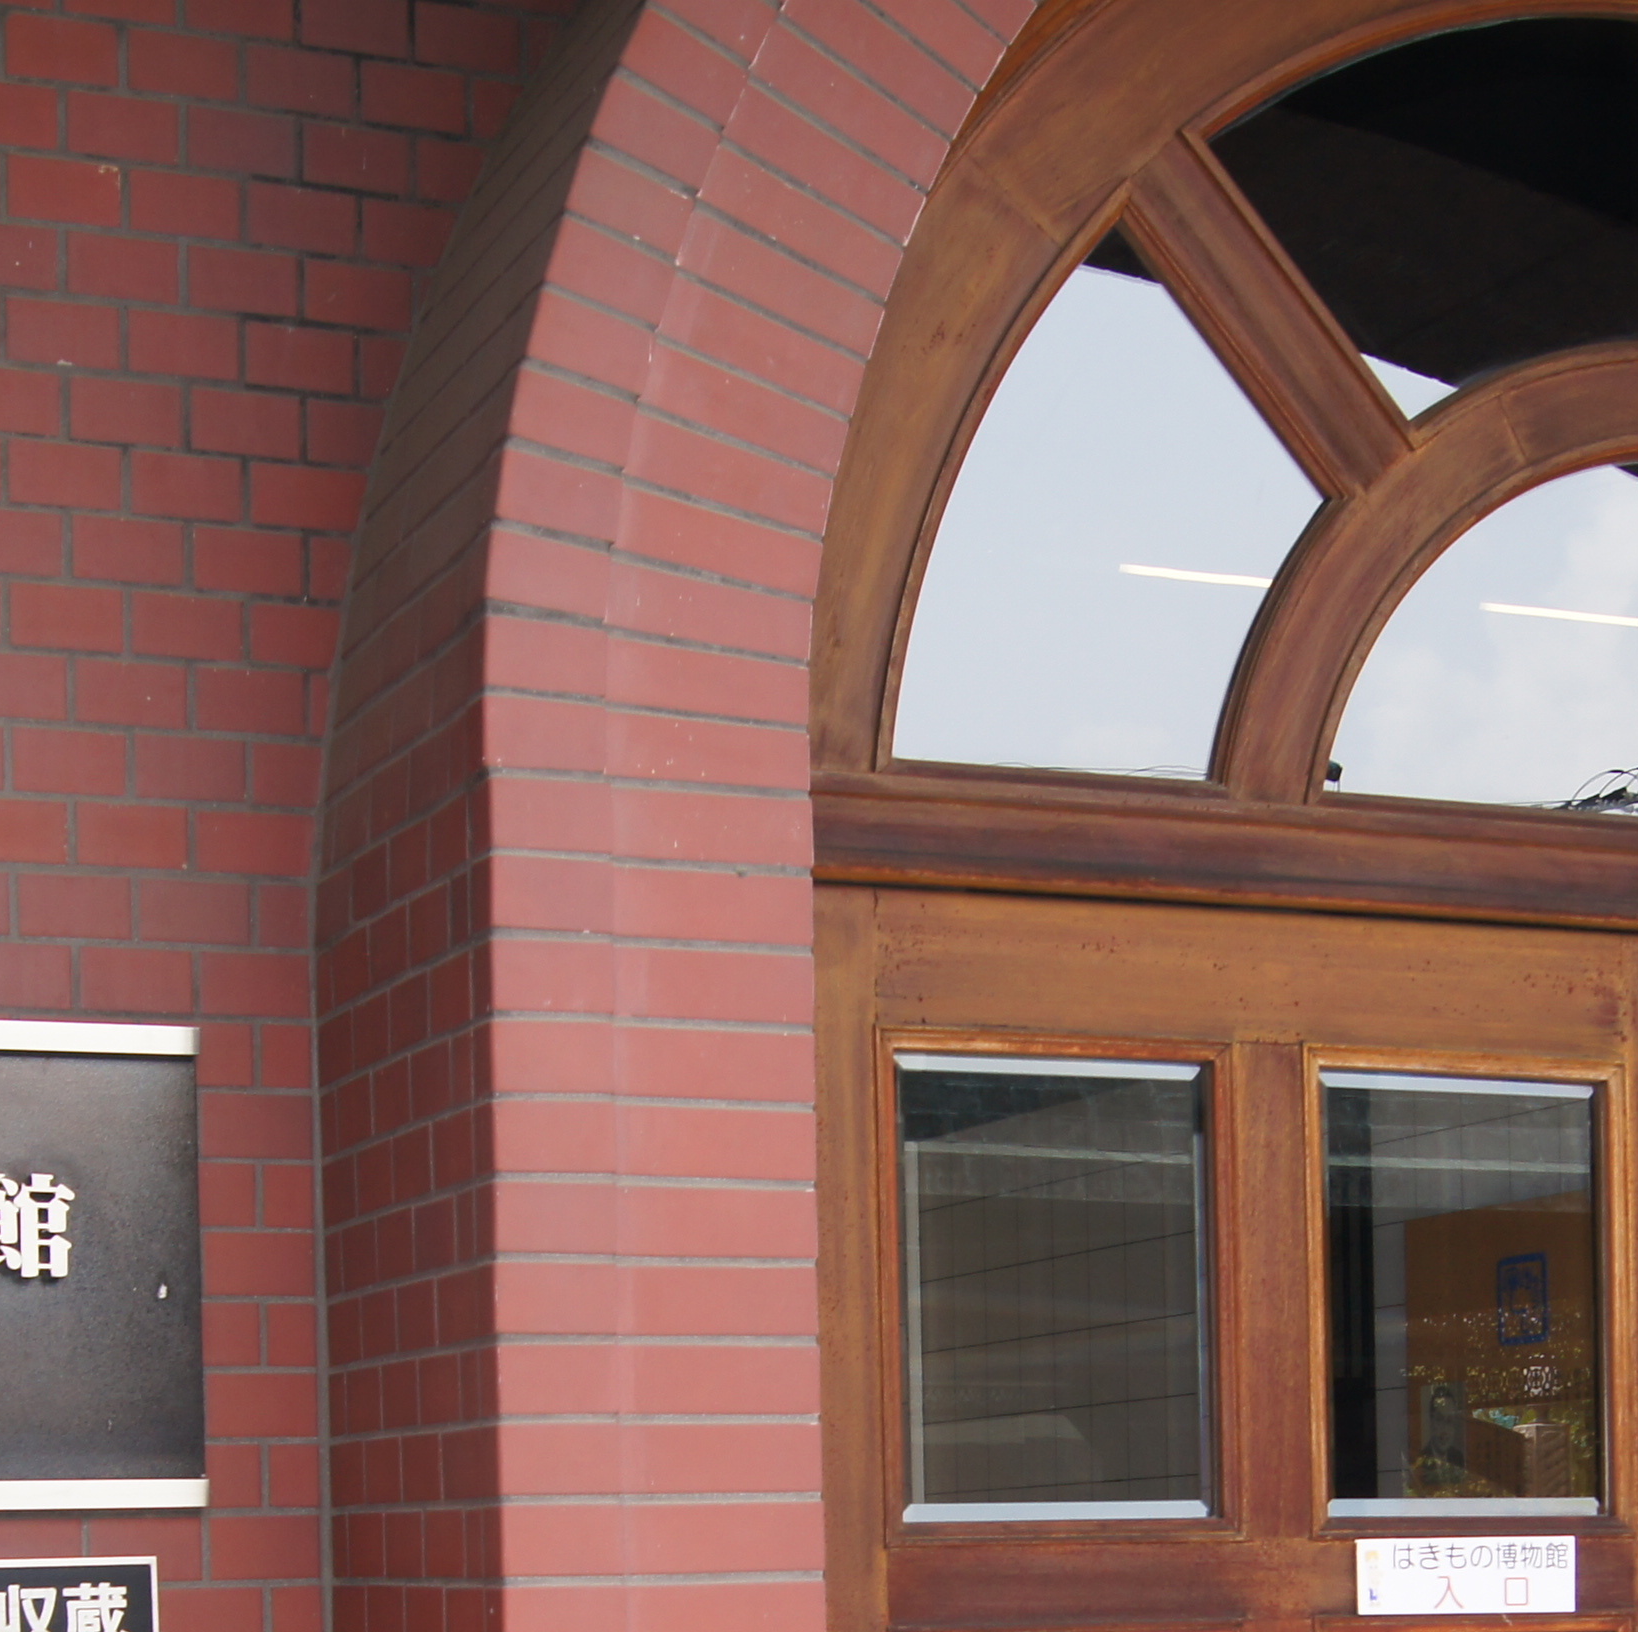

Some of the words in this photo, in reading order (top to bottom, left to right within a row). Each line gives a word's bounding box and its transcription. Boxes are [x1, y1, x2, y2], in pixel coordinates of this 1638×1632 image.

[1392, 1542, 1569, 1570] はきもの博物館
[1433, 1575, 1530, 1609] 入口
